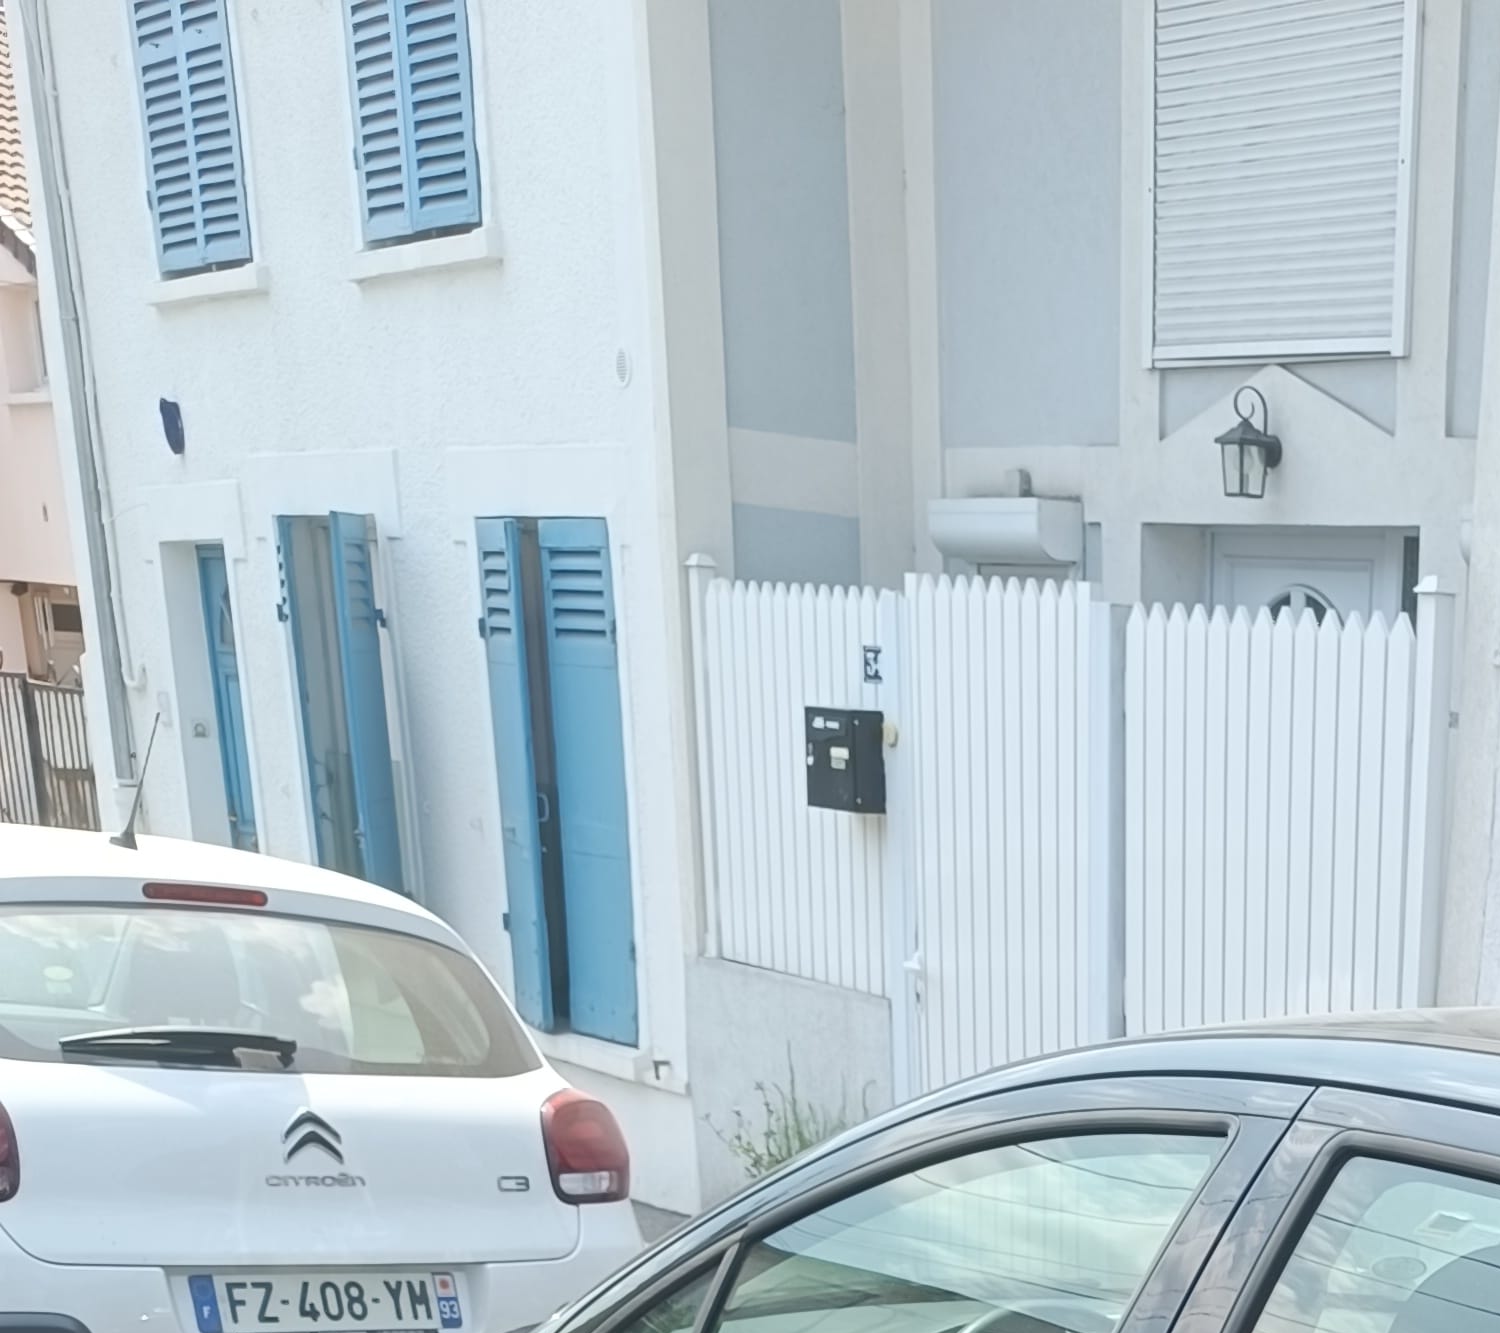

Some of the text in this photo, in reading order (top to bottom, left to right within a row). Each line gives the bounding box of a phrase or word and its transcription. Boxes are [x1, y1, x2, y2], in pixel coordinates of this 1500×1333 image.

[497, 1175, 530, 1192] C3
[203, 1280, 460, 1325] F FZ-408-YM 93
